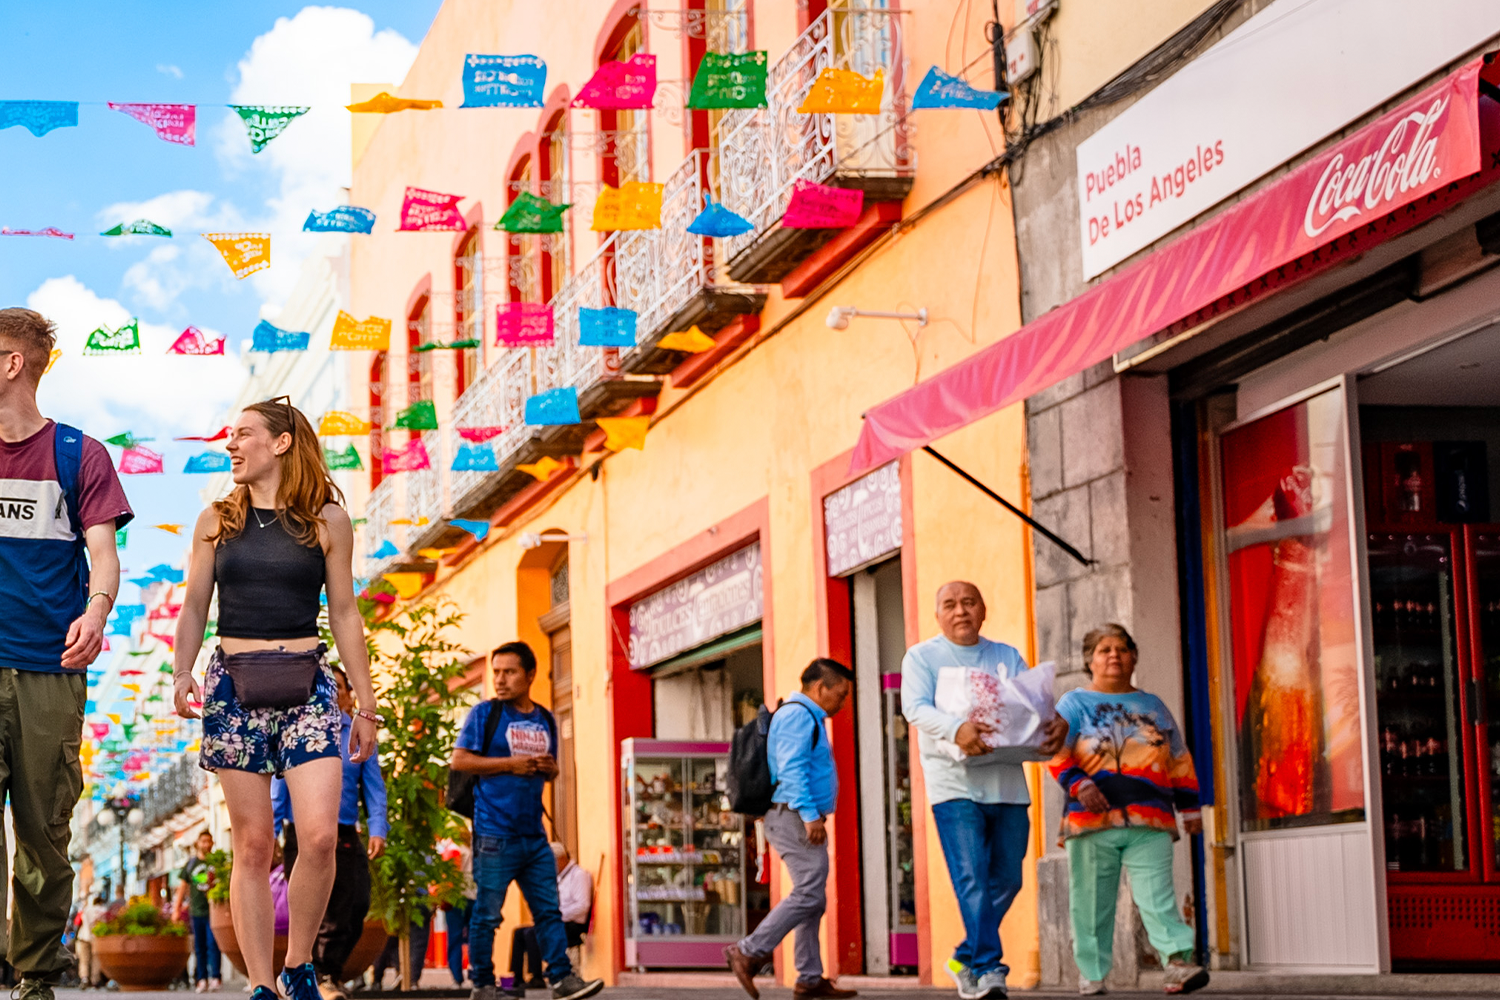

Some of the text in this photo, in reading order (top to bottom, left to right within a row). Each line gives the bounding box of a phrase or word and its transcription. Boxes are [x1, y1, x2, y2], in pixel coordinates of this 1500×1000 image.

[1085, 144, 1142, 202] Puebla
[1088, 139, 1225, 245] De Los Angeles
[1304, 94, 1450, 237] Coca-Cola
[510, 729, 546, 743] NINJA
